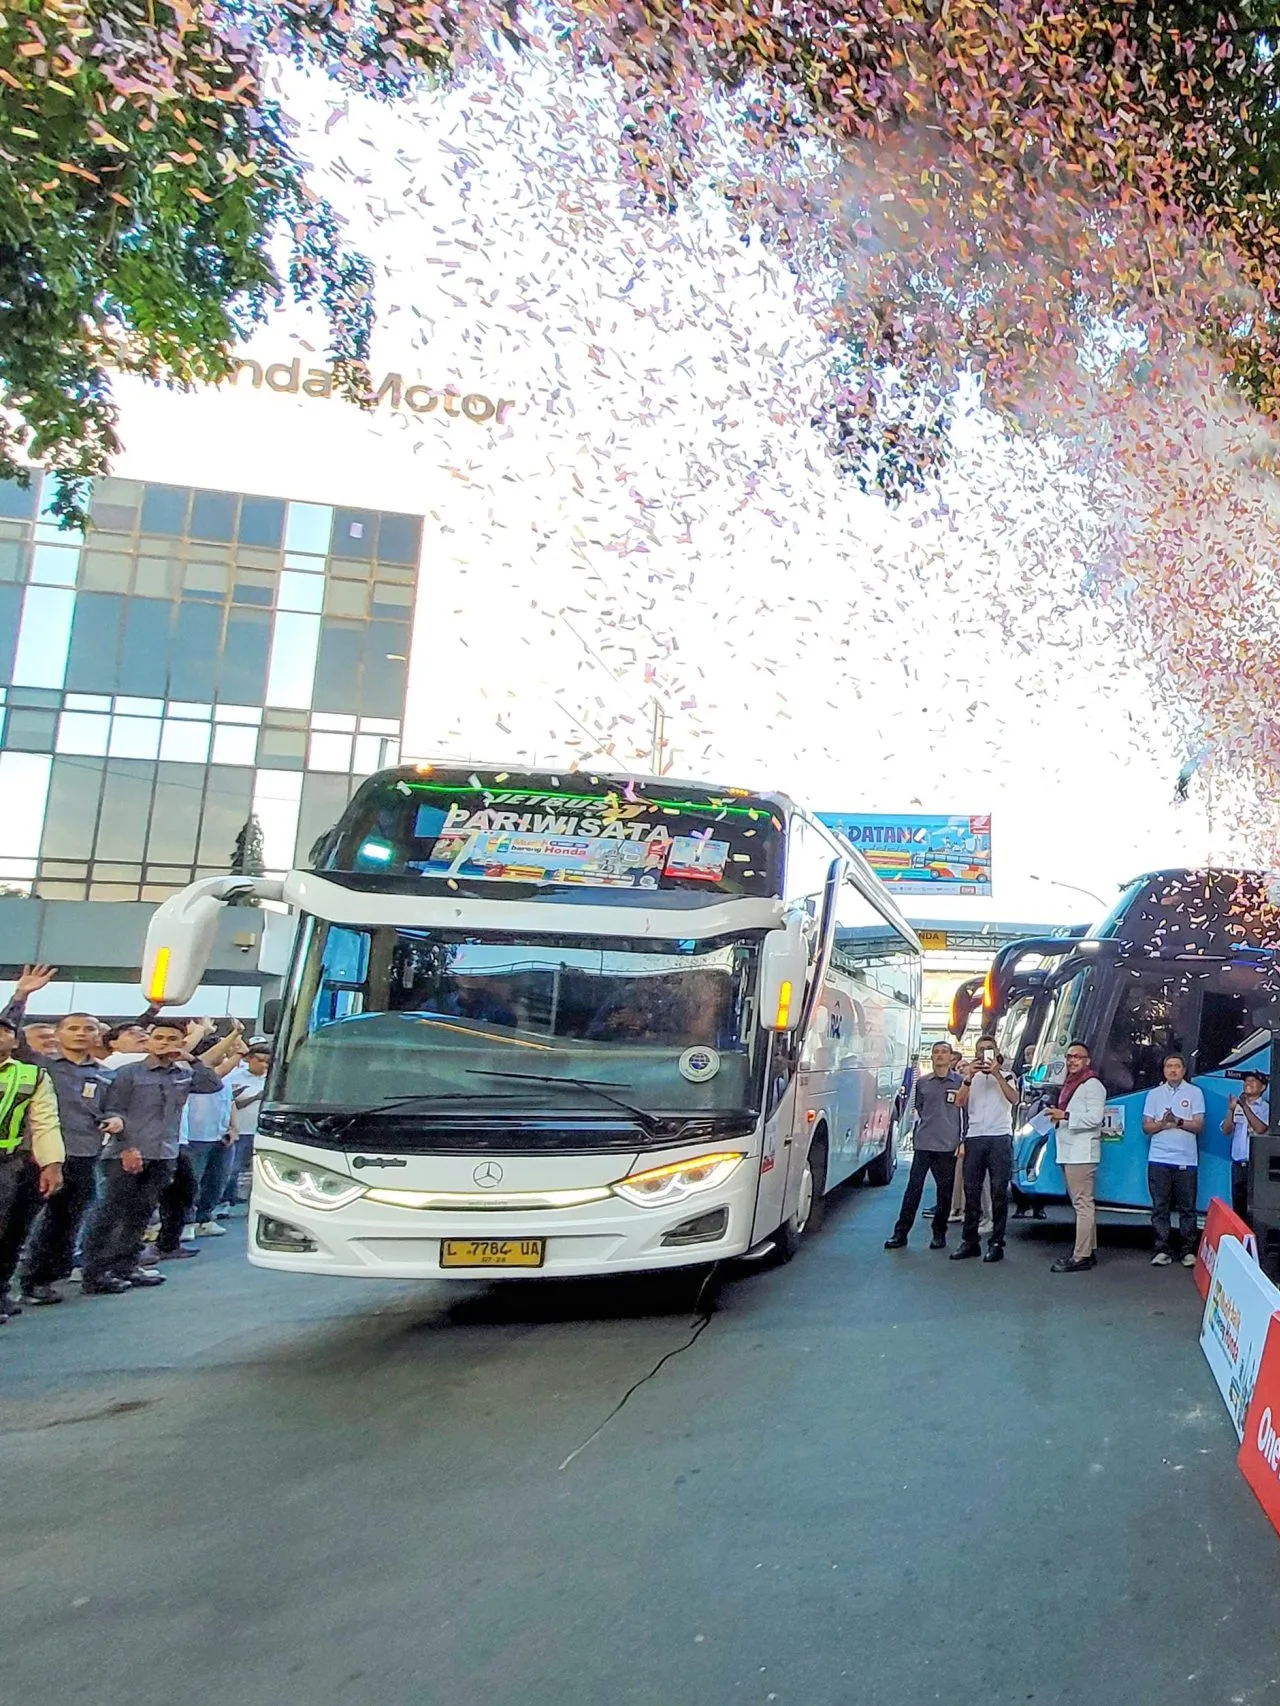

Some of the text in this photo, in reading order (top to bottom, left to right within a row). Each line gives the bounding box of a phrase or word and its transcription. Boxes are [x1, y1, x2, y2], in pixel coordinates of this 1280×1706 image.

[442, 807, 671, 842] PARIWISATA
[447, 1242, 457, 1256] L
[521, 1241, 540, 1256] UA
